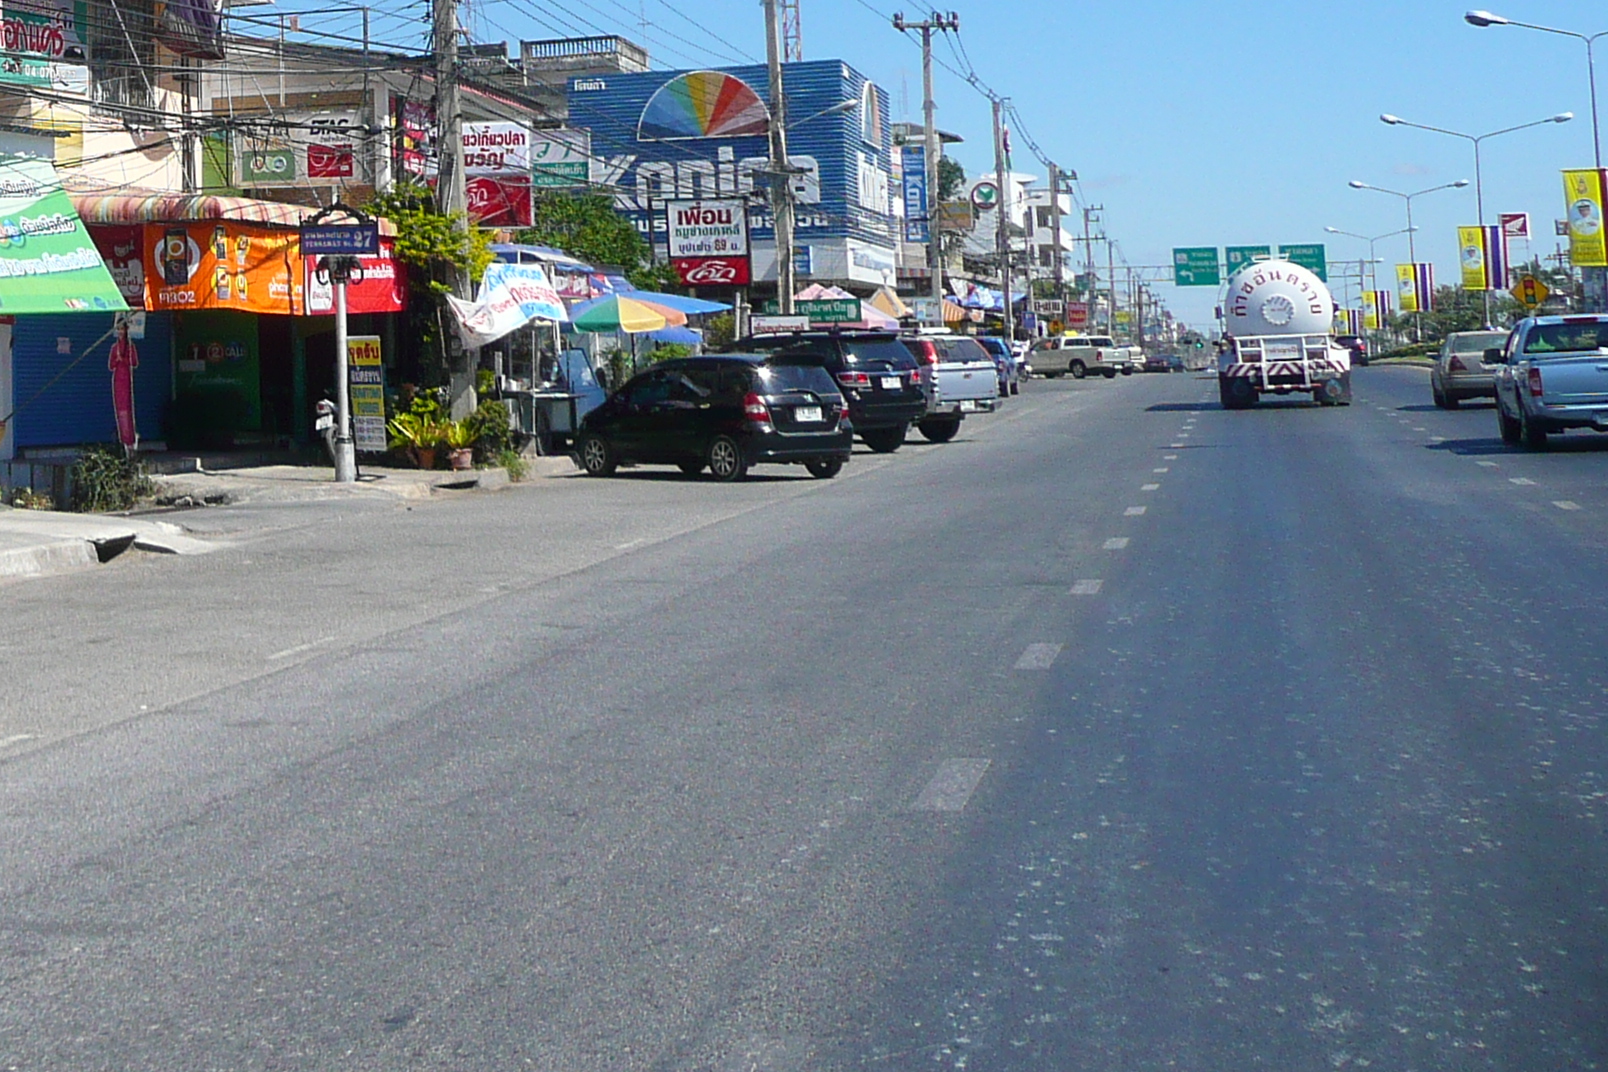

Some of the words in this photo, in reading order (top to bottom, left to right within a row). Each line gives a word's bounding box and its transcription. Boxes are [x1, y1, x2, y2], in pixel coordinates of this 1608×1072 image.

[677, 201, 732, 226] เพื่อน
[353, 231, 372, 248] 27
